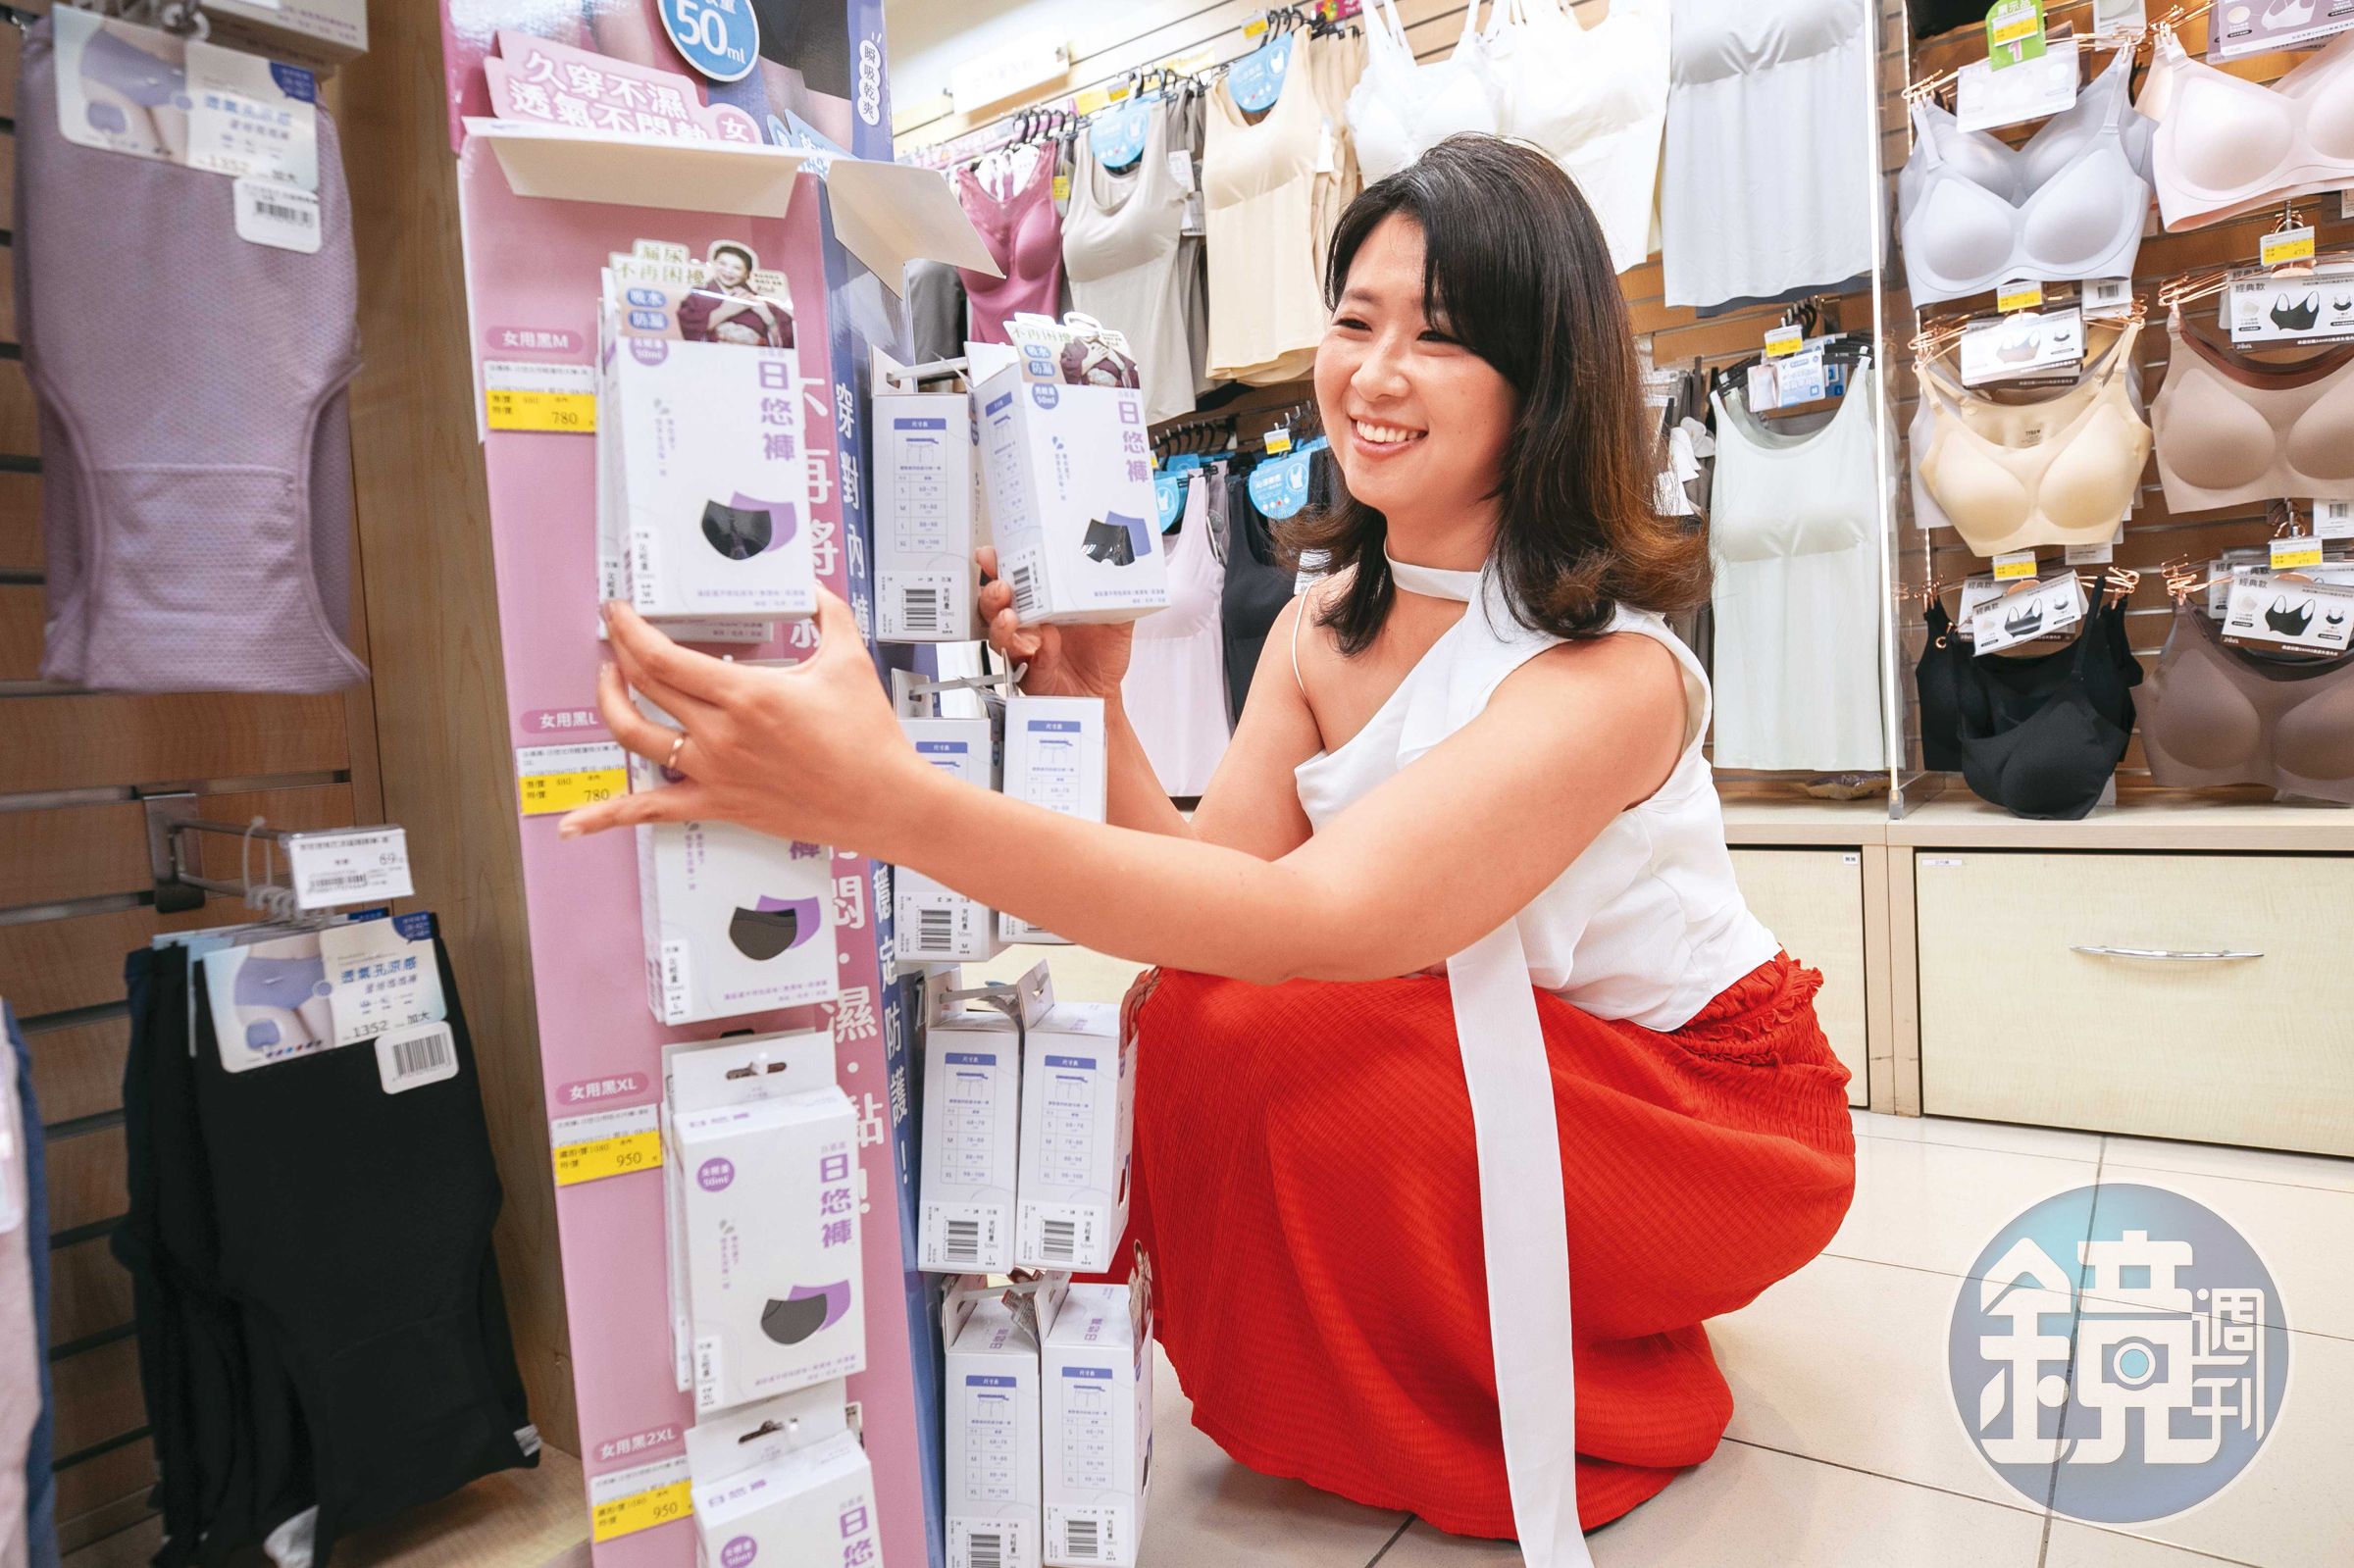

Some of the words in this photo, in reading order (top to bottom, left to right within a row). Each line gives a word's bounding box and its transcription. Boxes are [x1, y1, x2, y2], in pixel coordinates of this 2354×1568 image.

[526, 52, 688, 121] 久穿不濕
[863, 45, 877, 120] 瞬吸乾爽
[620, 263, 705, 285] 不再困擾
[2235, 282, 2265, 293] 經典款
[633, 312, 666, 329] 防漏
[502, 330, 569, 348] 女用黑M
[551, 412, 579, 425] 780
[757, 361, 796, 463] 日悠褲
[1118, 401, 1150, 483] 日悠褲
[2239, 577, 2268, 588] 經典款
[539, 711, 598, 730] 女用黑L
[583, 788, 609, 802] 780
[353, 1020, 388, 1037] 1352
[570, 1078, 638, 1102] 女用黑XL
[616, 1152, 642, 1167] 950
[820, 1153, 853, 1249] 日悠褲
[601, 1428, 676, 1460] 女用黑2XL
[652, 1501, 679, 1519] 950
[839, 1505, 874, 1568] 日悠
